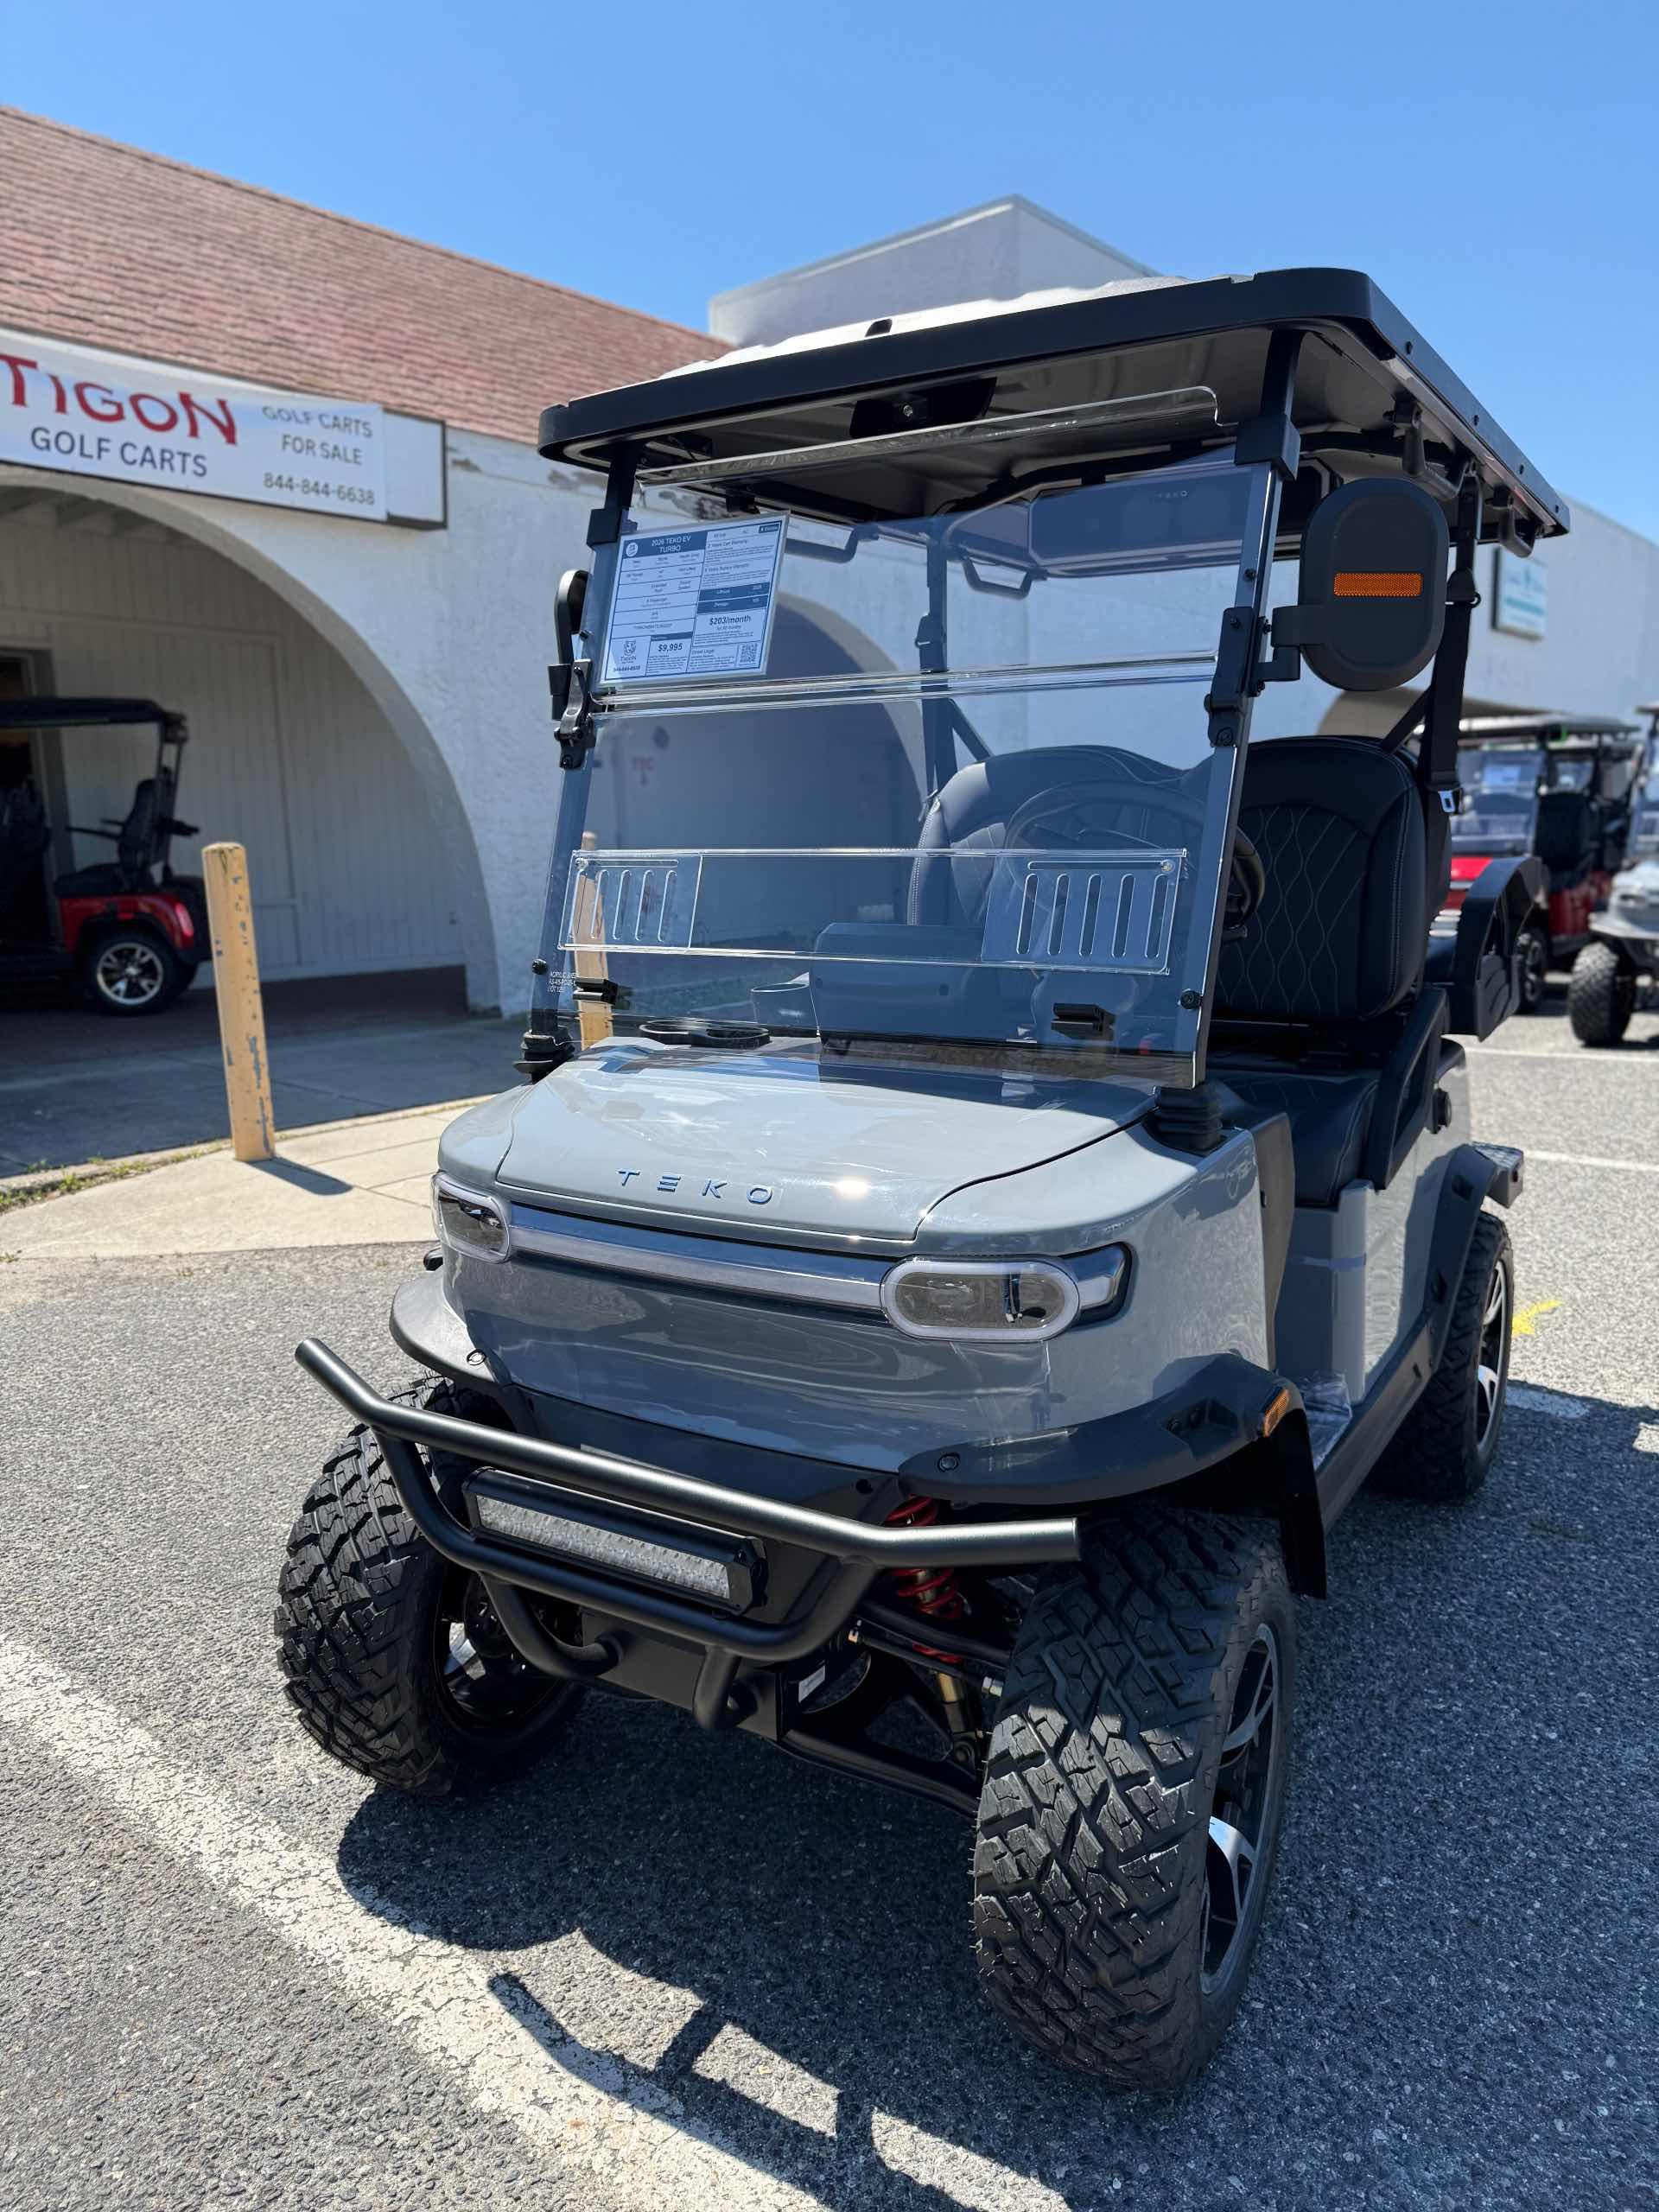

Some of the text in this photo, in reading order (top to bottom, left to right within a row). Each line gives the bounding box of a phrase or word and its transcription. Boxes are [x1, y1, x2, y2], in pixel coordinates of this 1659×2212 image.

[0, 353, 238, 447] TIGON
[262, 405, 373, 439] GOLF CARTS
[30, 426, 208, 478] GOLF CARTS
[281, 433, 362, 466] FOR SALE
[263, 472, 375, 505] 844-844-6638
[659, 544, 682, 553] TURBO
[666, 537, 682, 545] TEKO
[709, 614, 751, 626] $203/month
[658, 643, 683, 652] $9,995
[617, 1168, 774, 1206] TEKO
